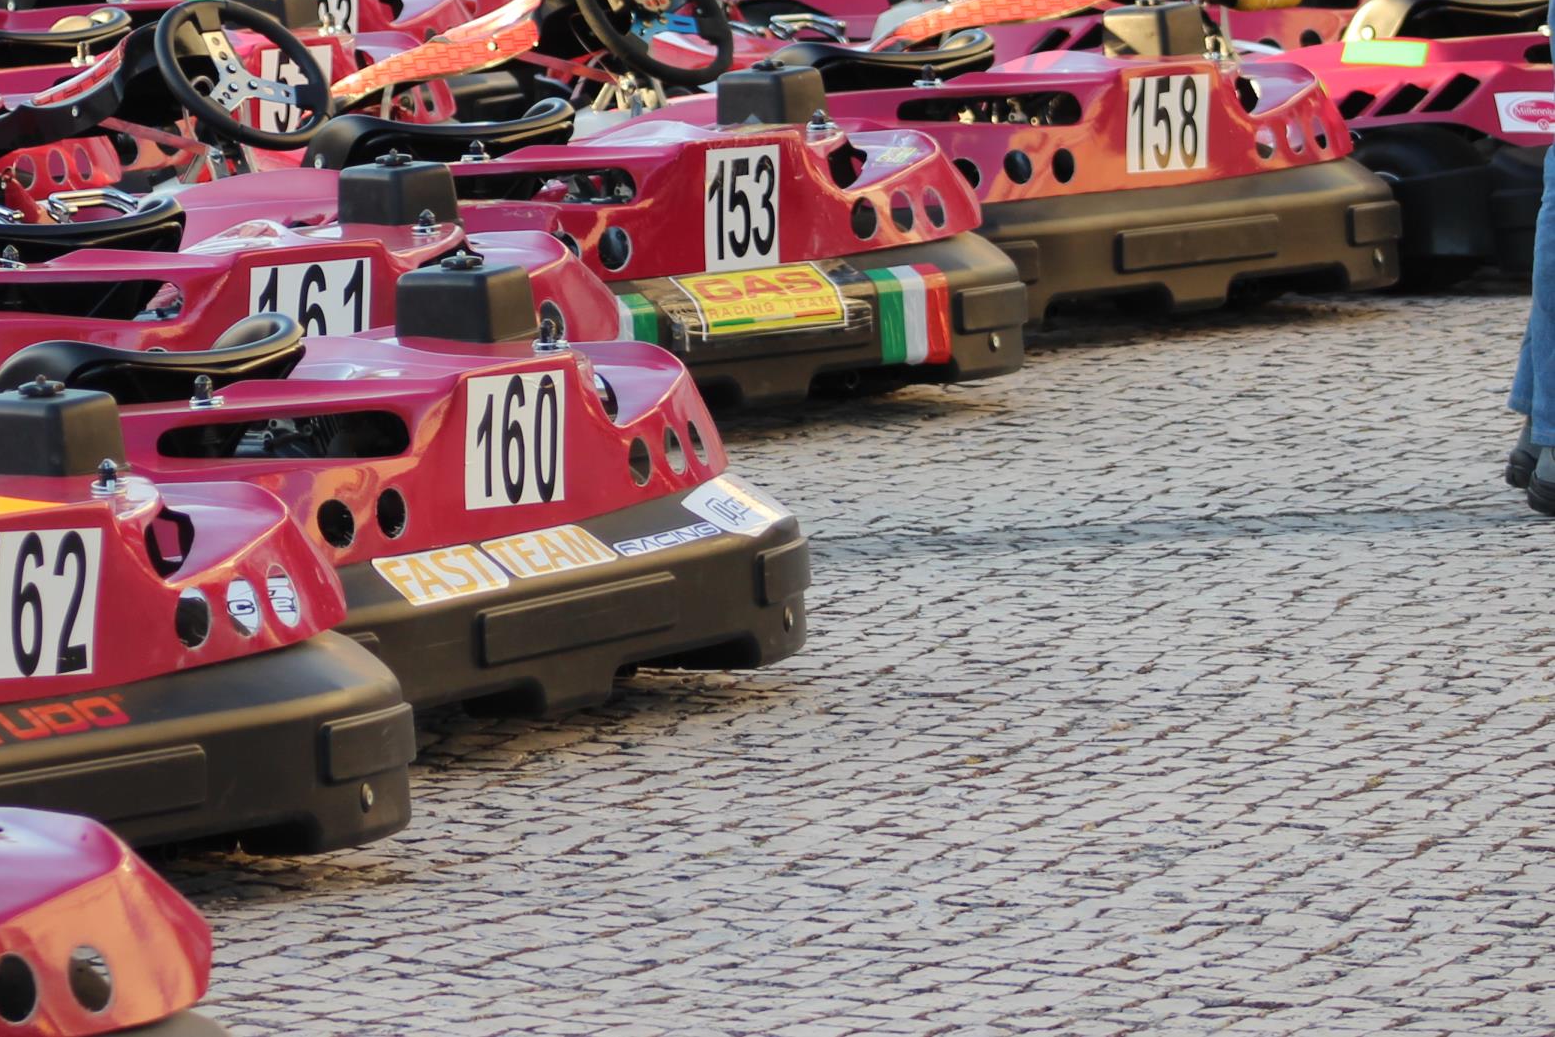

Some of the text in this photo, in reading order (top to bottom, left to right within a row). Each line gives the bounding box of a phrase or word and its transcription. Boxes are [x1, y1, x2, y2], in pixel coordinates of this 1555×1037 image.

[1131, 75, 1198, 170] 158
[708, 154, 776, 261] 153
[258, 260, 364, 338] 161
[695, 270, 824, 304] GAS
[708, 295, 837, 319] RACING TEAM
[476, 374, 558, 505] 160
[376, 522, 722, 603] FAST TEAM RACING
